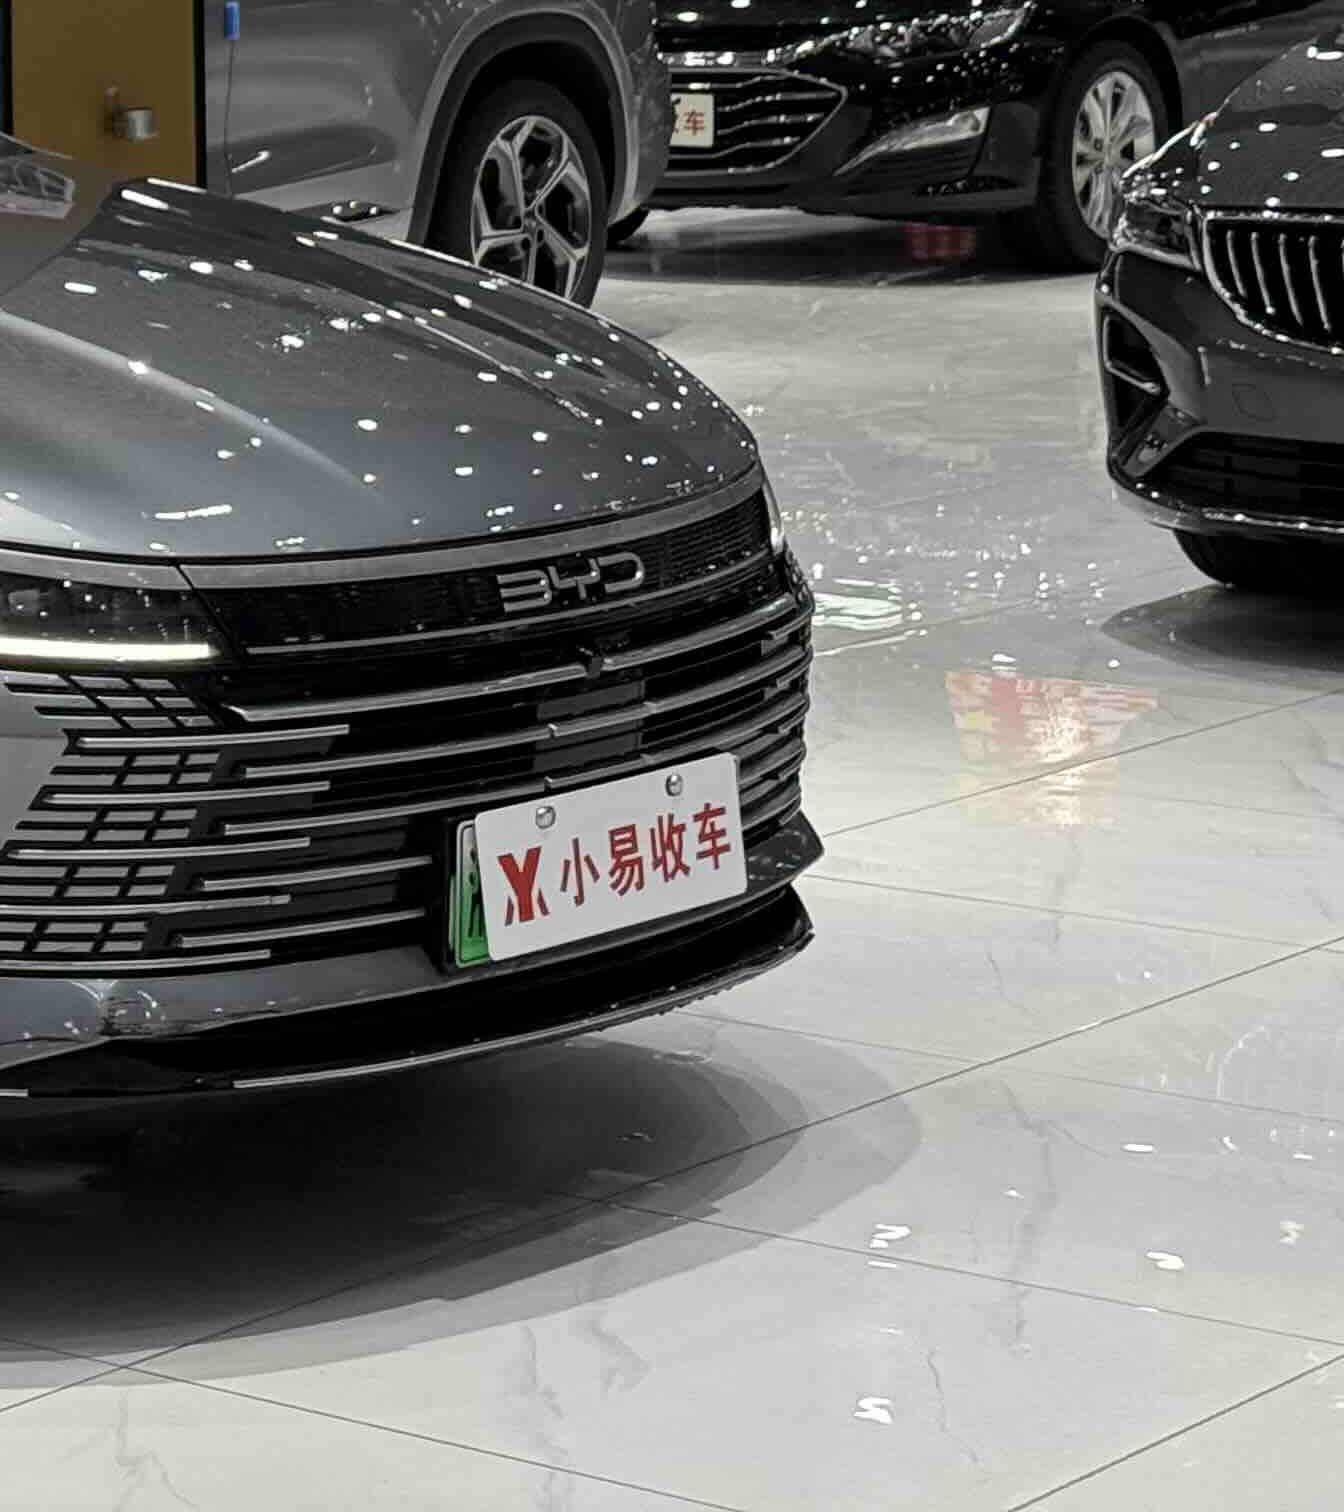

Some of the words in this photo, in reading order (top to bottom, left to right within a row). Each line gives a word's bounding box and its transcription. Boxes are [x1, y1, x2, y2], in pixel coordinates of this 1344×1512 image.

[496, 552, 645, 612] BYD
[560, 801, 732, 906] 小易收车
